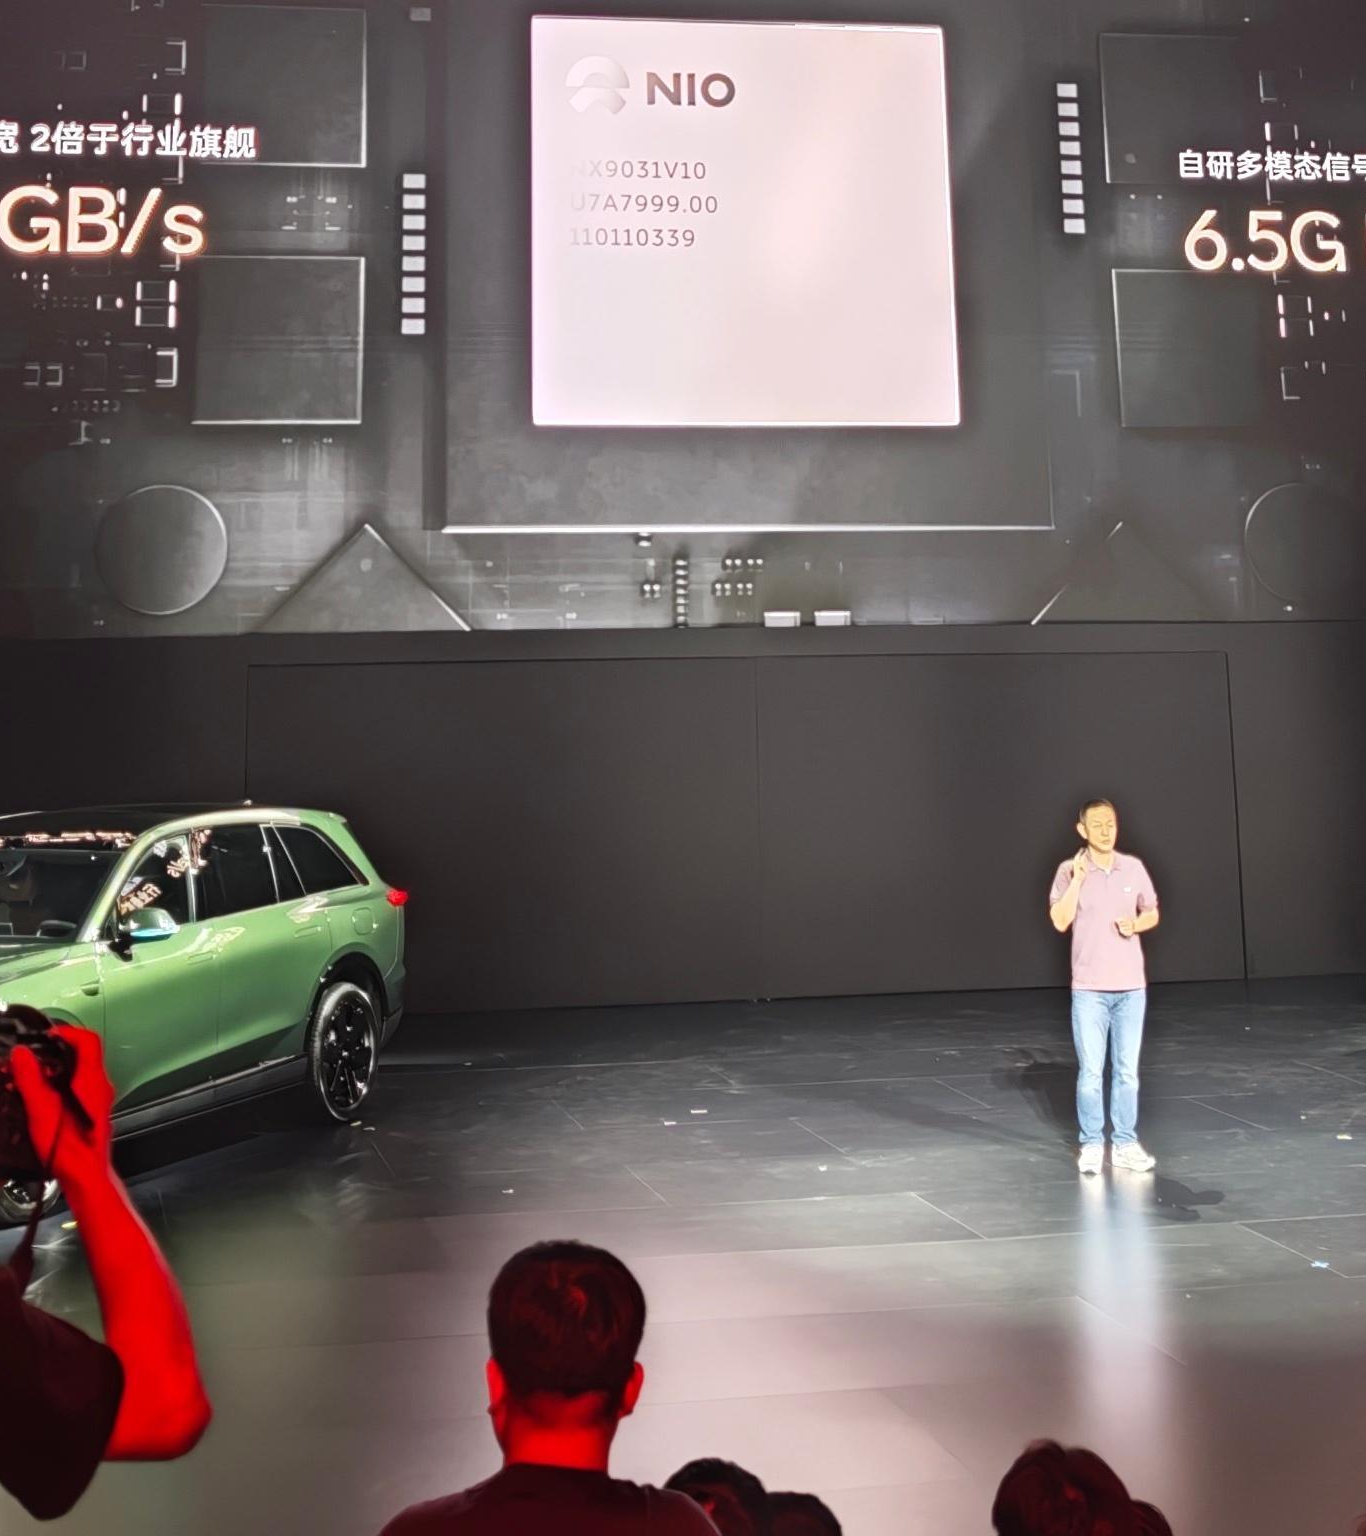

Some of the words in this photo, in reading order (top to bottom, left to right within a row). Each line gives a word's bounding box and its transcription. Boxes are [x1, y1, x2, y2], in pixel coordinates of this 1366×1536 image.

[645, 71, 736, 108] NIO
[30, 121, 257, 159] 2倍于行业旗舰
[570, 228, 696, 247] 110110339
[1184, 209, 1347, 273] 6.5G
